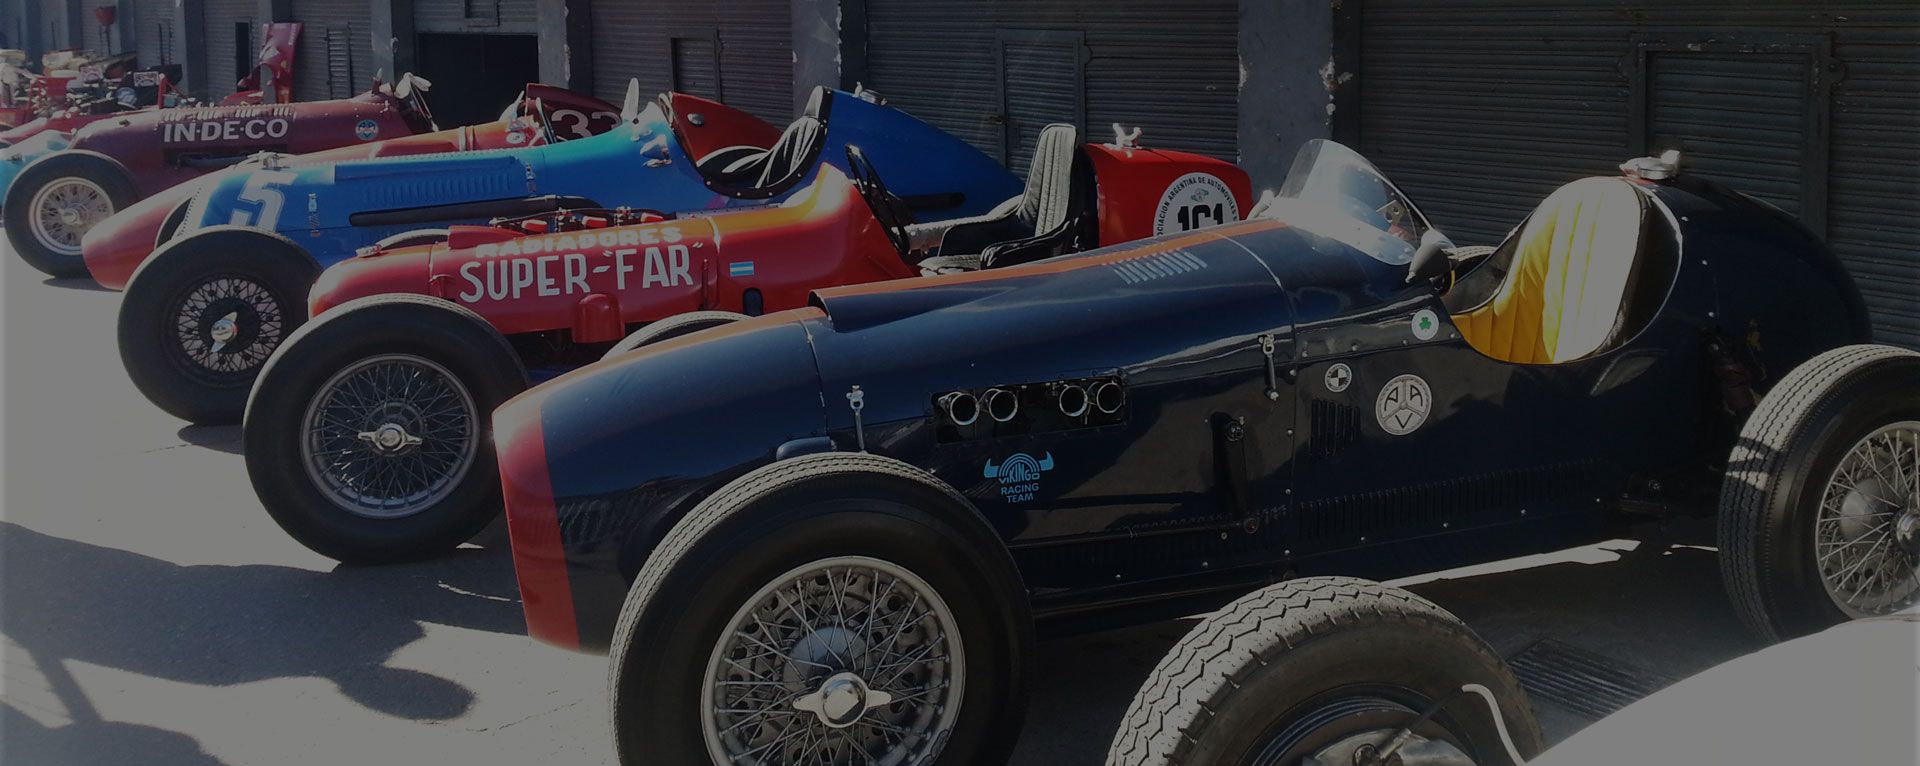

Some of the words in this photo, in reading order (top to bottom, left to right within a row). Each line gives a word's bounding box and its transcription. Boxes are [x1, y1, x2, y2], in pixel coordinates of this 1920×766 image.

[1198, 176, 1206, 184] DE
[228, 172, 298, 230] 5
[1000, 482, 1040, 495] RACING
[1006, 493, 1034, 503] TEAM
